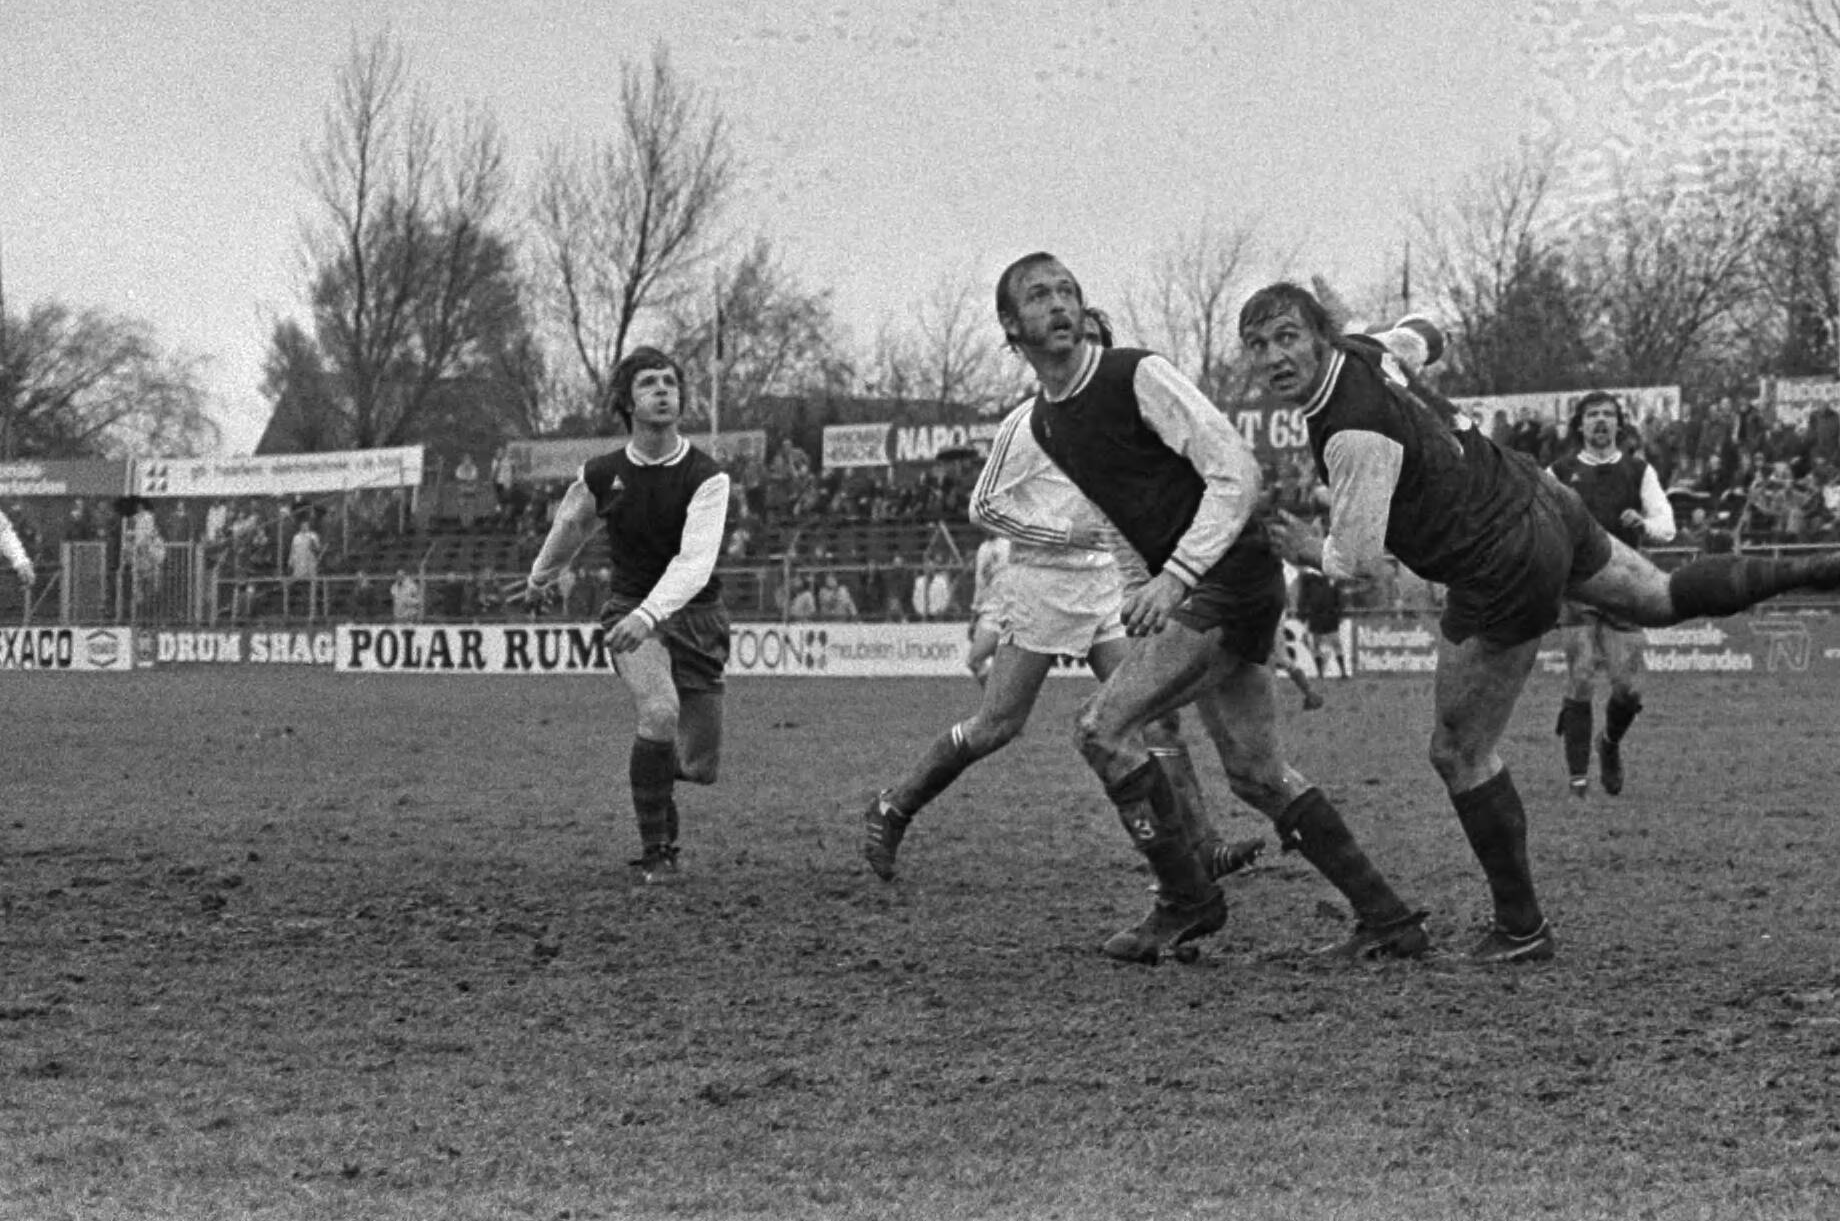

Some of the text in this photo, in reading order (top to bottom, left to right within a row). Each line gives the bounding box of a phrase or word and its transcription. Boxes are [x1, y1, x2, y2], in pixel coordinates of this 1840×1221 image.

[1269, 408, 1310, 449] 69
[158, 632, 335, 663] DRUM SHAG
[349, 630, 609, 670] POLAR RUM
